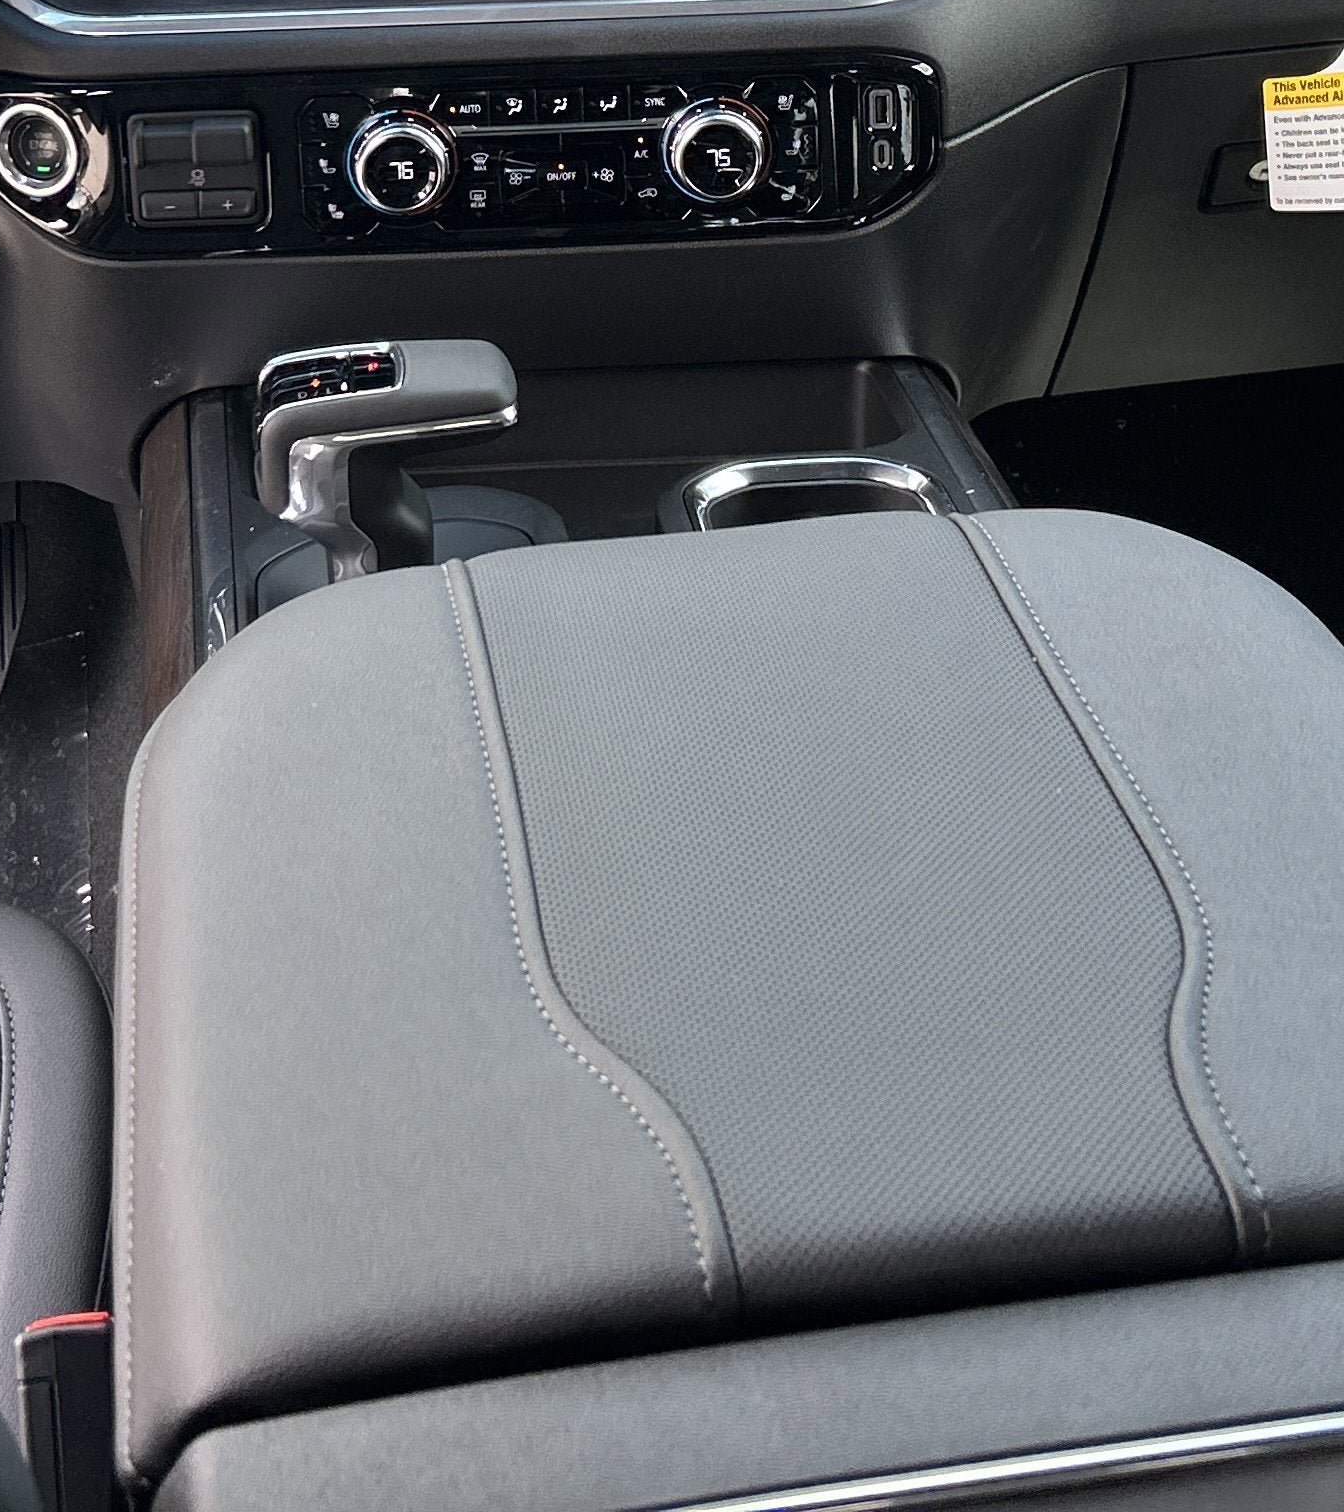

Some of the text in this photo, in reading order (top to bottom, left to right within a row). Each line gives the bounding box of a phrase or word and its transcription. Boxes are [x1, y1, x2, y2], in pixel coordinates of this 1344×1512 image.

[1272, 82, 1296, 93] This
[1300, 77, 1341, 90] Vehicle
[644, 97, 666, 107] SYNC
[1273, 92, 1329, 106] Advanced
[459, 104, 482, 114] AUTO
[634, 149, 649, 159] A/C
[706, 148, 731, 167] 75
[389, 161, 414, 179] 76
[546, 172, 577, 182] ON/OFF
